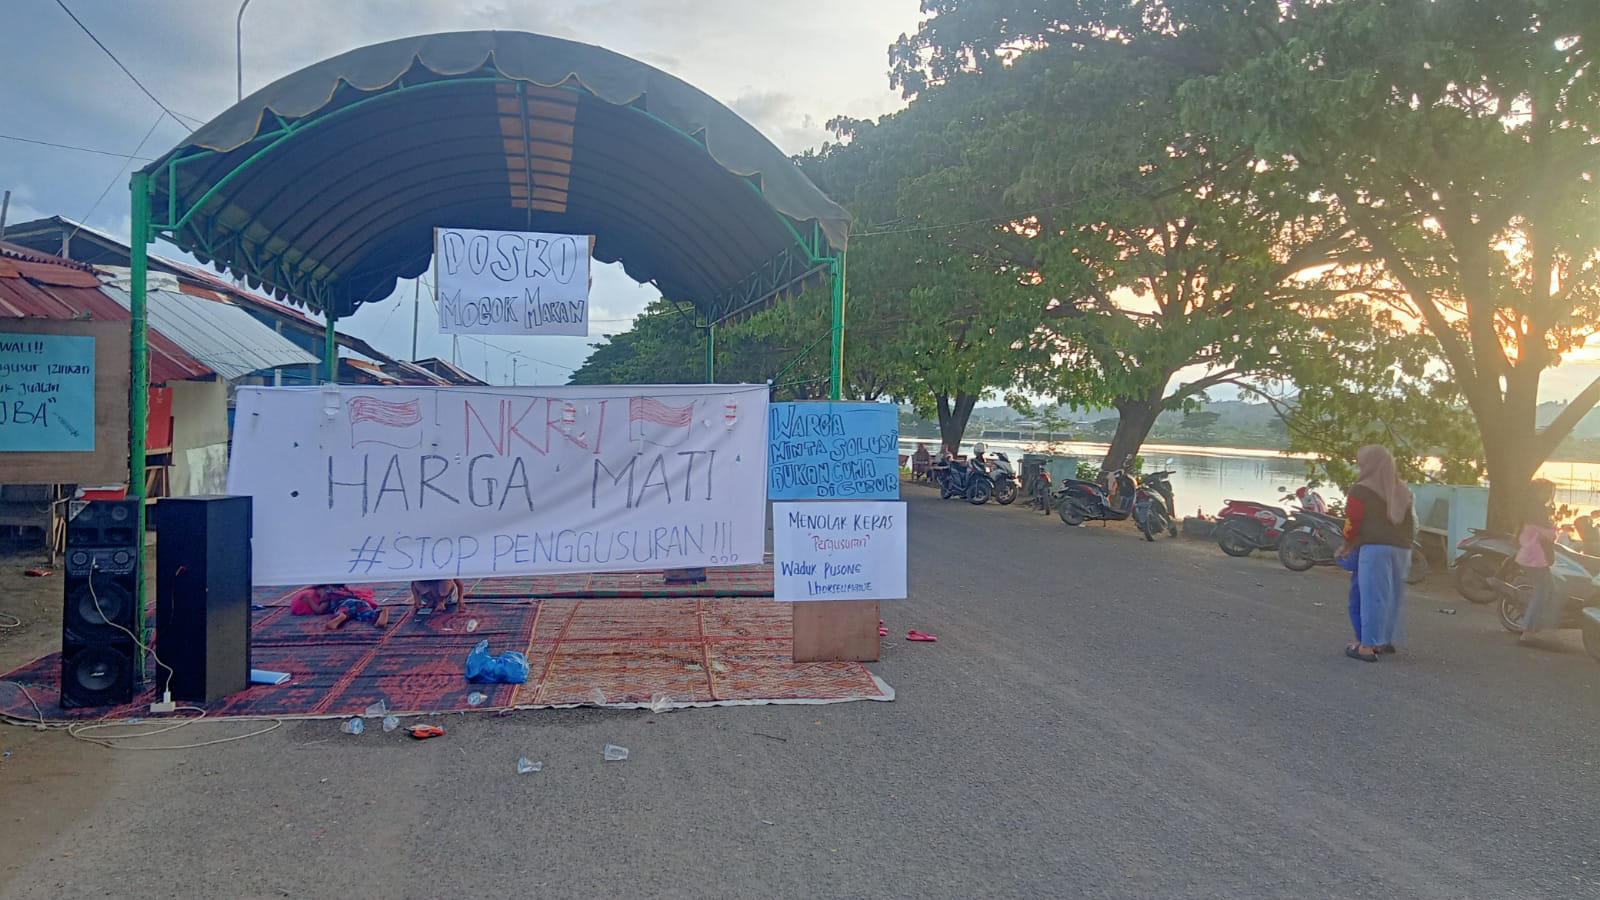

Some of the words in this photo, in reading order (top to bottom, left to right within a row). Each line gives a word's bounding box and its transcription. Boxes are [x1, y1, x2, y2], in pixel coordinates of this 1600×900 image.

[443, 232, 577, 284] POSKO
[441, 289, 518, 329] MOGOK
[524, 286, 584, 329] MAKAN
[465, 397, 608, 456] NKRI
[772, 404, 846, 440] WARGA
[328, 453, 534, 517] HARGA
[592, 449, 716, 508] MATI
[771, 462, 830, 492] BUKAN
[831, 459, 877, 483] CUMA
[789, 511, 848, 531] MENOLAK
[854, 514, 894, 532] KERAS
[348, 535, 480, 577] #STOP
[781, 560, 817, 577] Waduk
